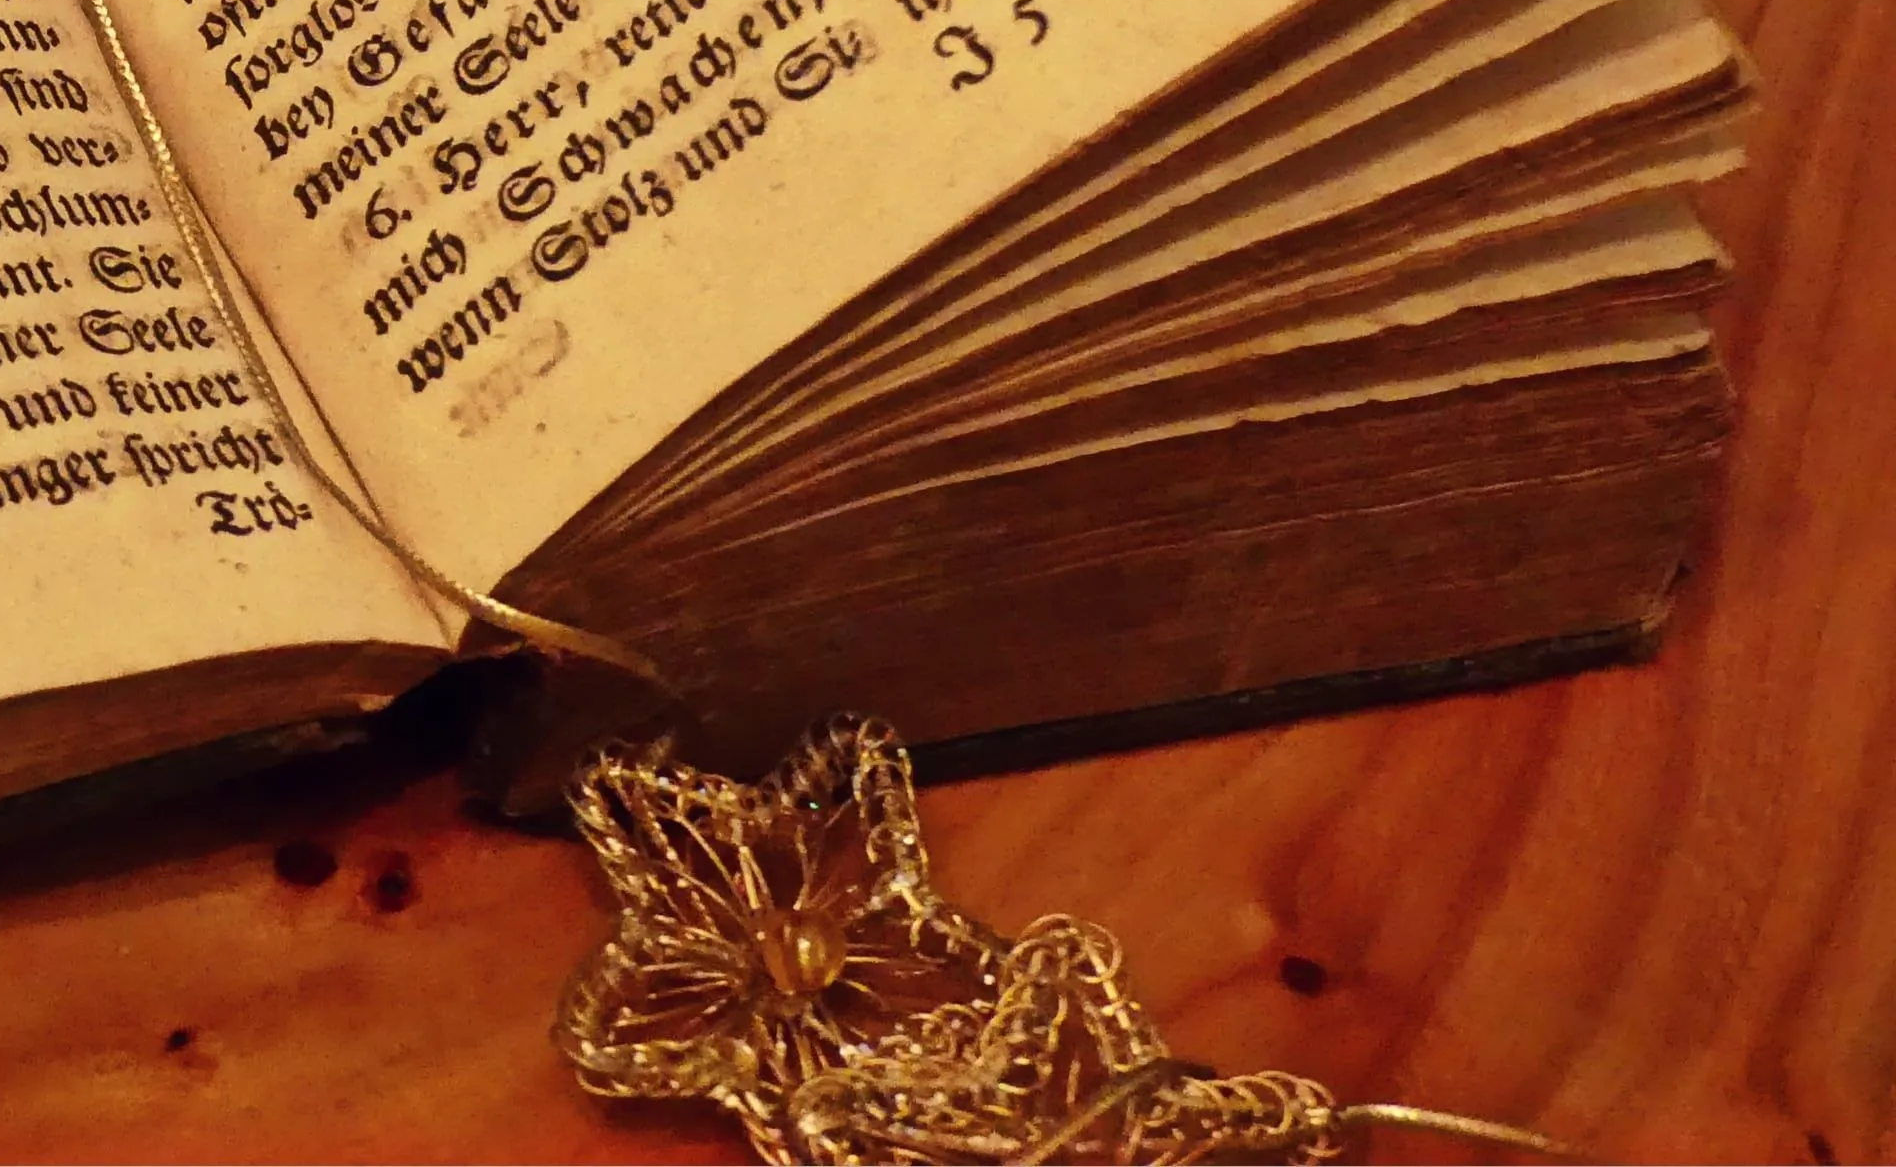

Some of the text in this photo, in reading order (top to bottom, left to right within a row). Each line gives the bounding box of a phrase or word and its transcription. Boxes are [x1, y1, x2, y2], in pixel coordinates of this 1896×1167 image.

[293, 85, 448, 220] meiner
[363, 228, 468, 336] mich
[397, 275, 523, 394] wenn
[674, 96, 769, 181] und
